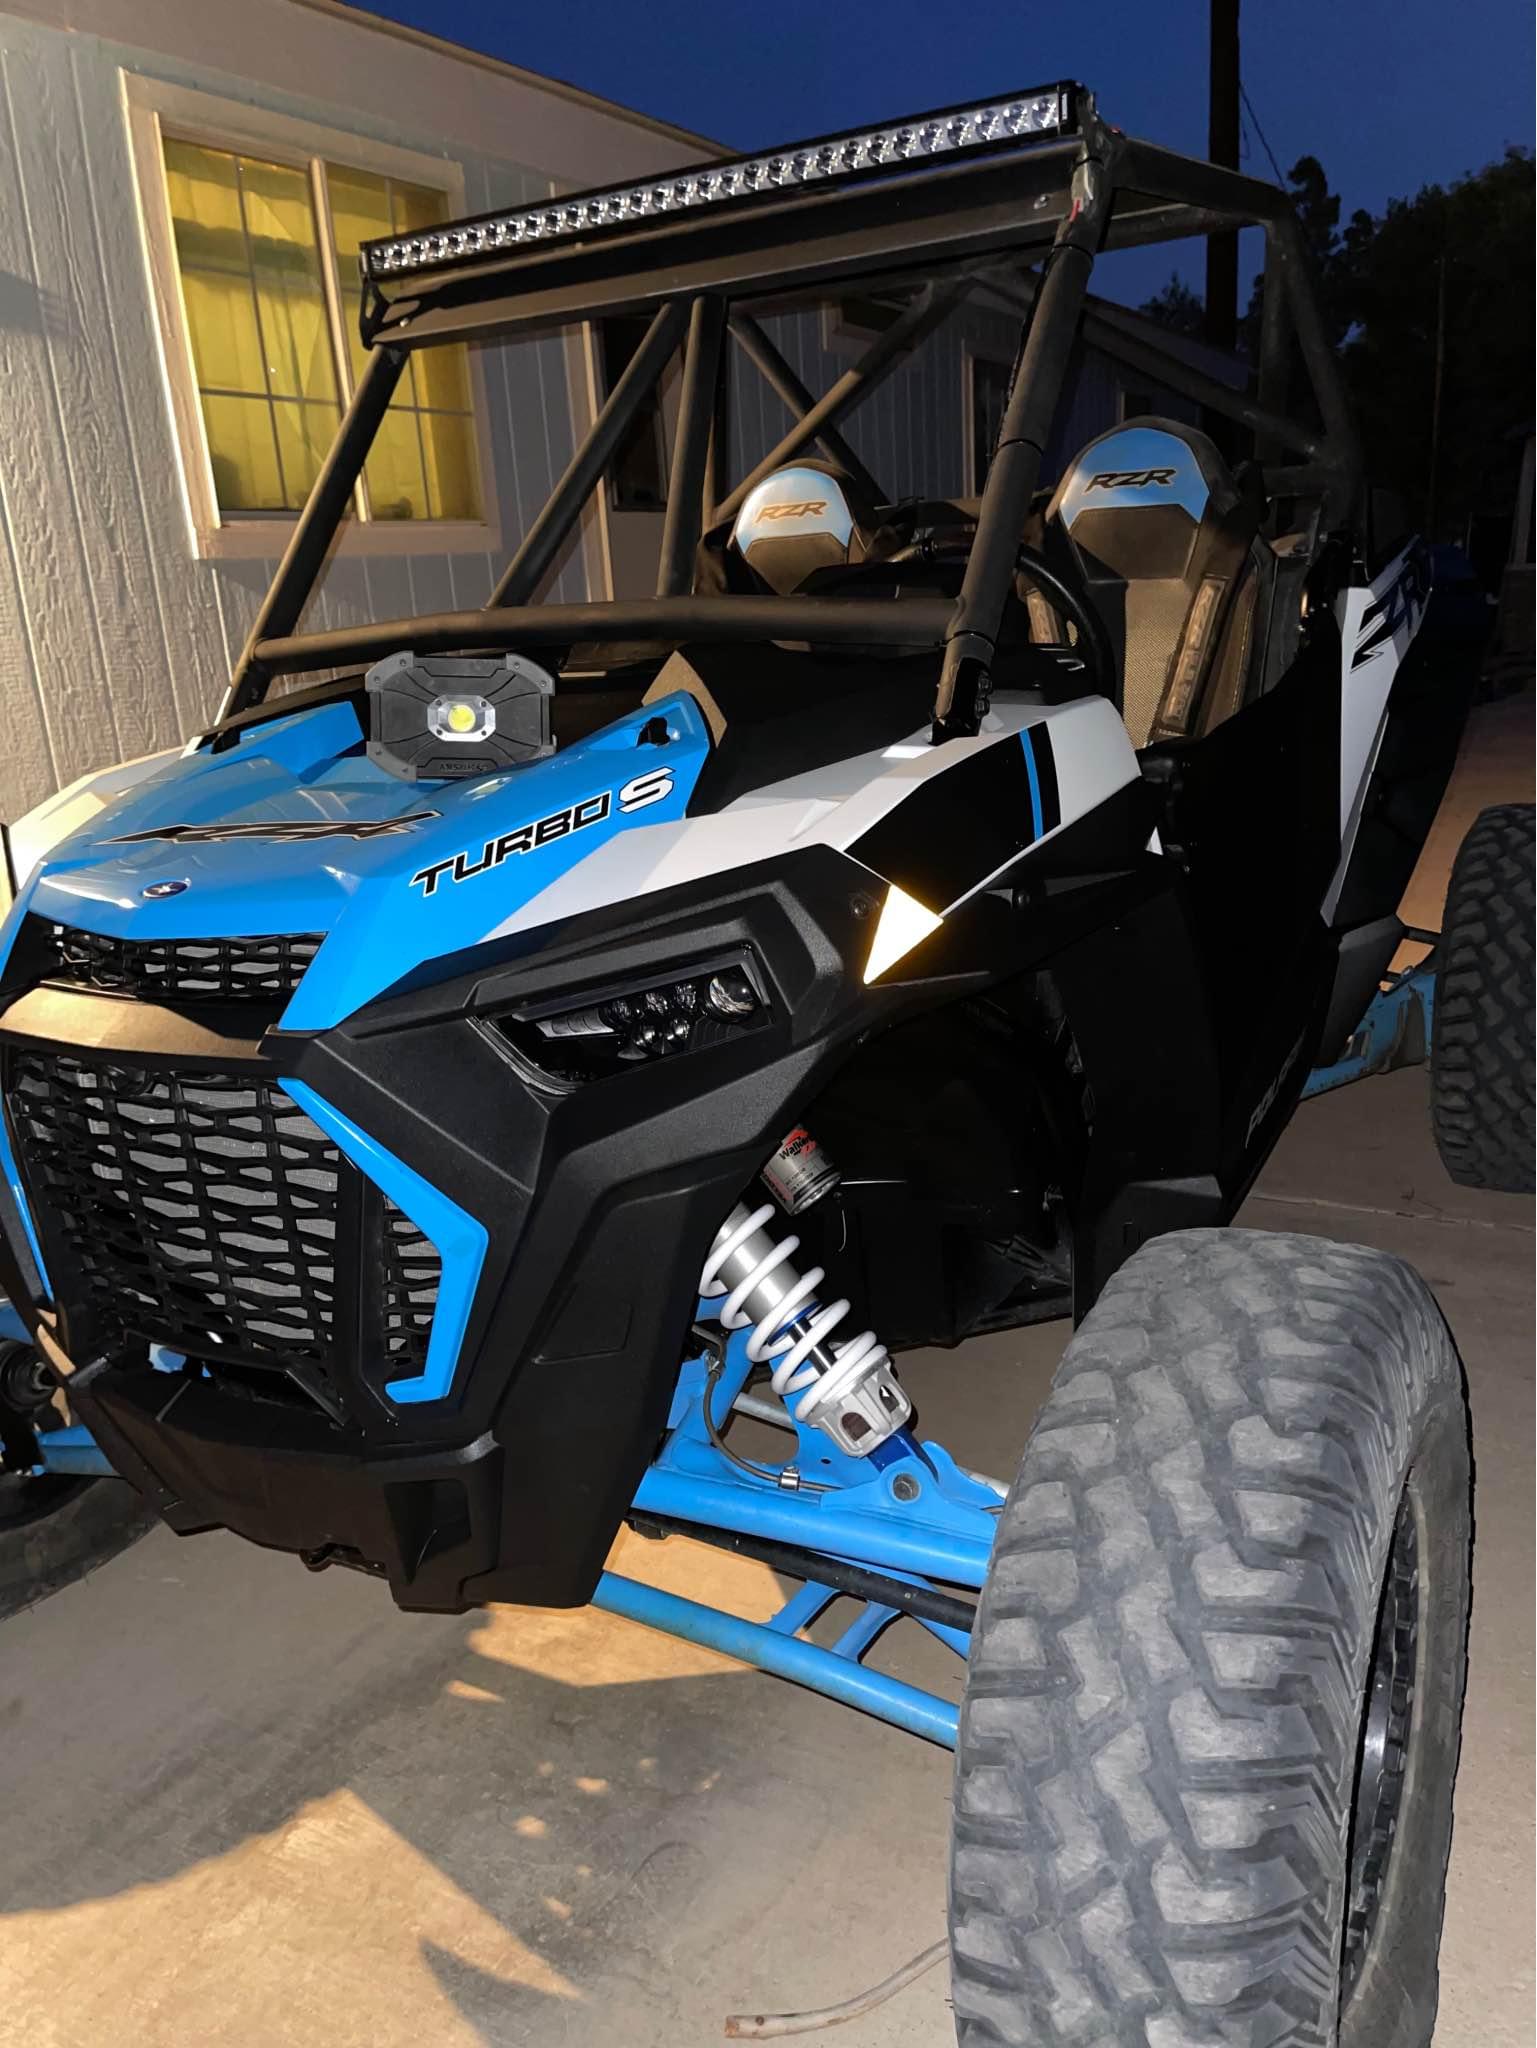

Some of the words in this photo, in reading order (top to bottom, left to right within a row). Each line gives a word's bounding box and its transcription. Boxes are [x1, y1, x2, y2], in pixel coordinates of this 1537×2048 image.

[1082, 467, 1177, 495] RZR
[753, 500, 829, 525] RZR
[408, 789, 613, 897] TURBO
[615, 765, 676, 814] S
